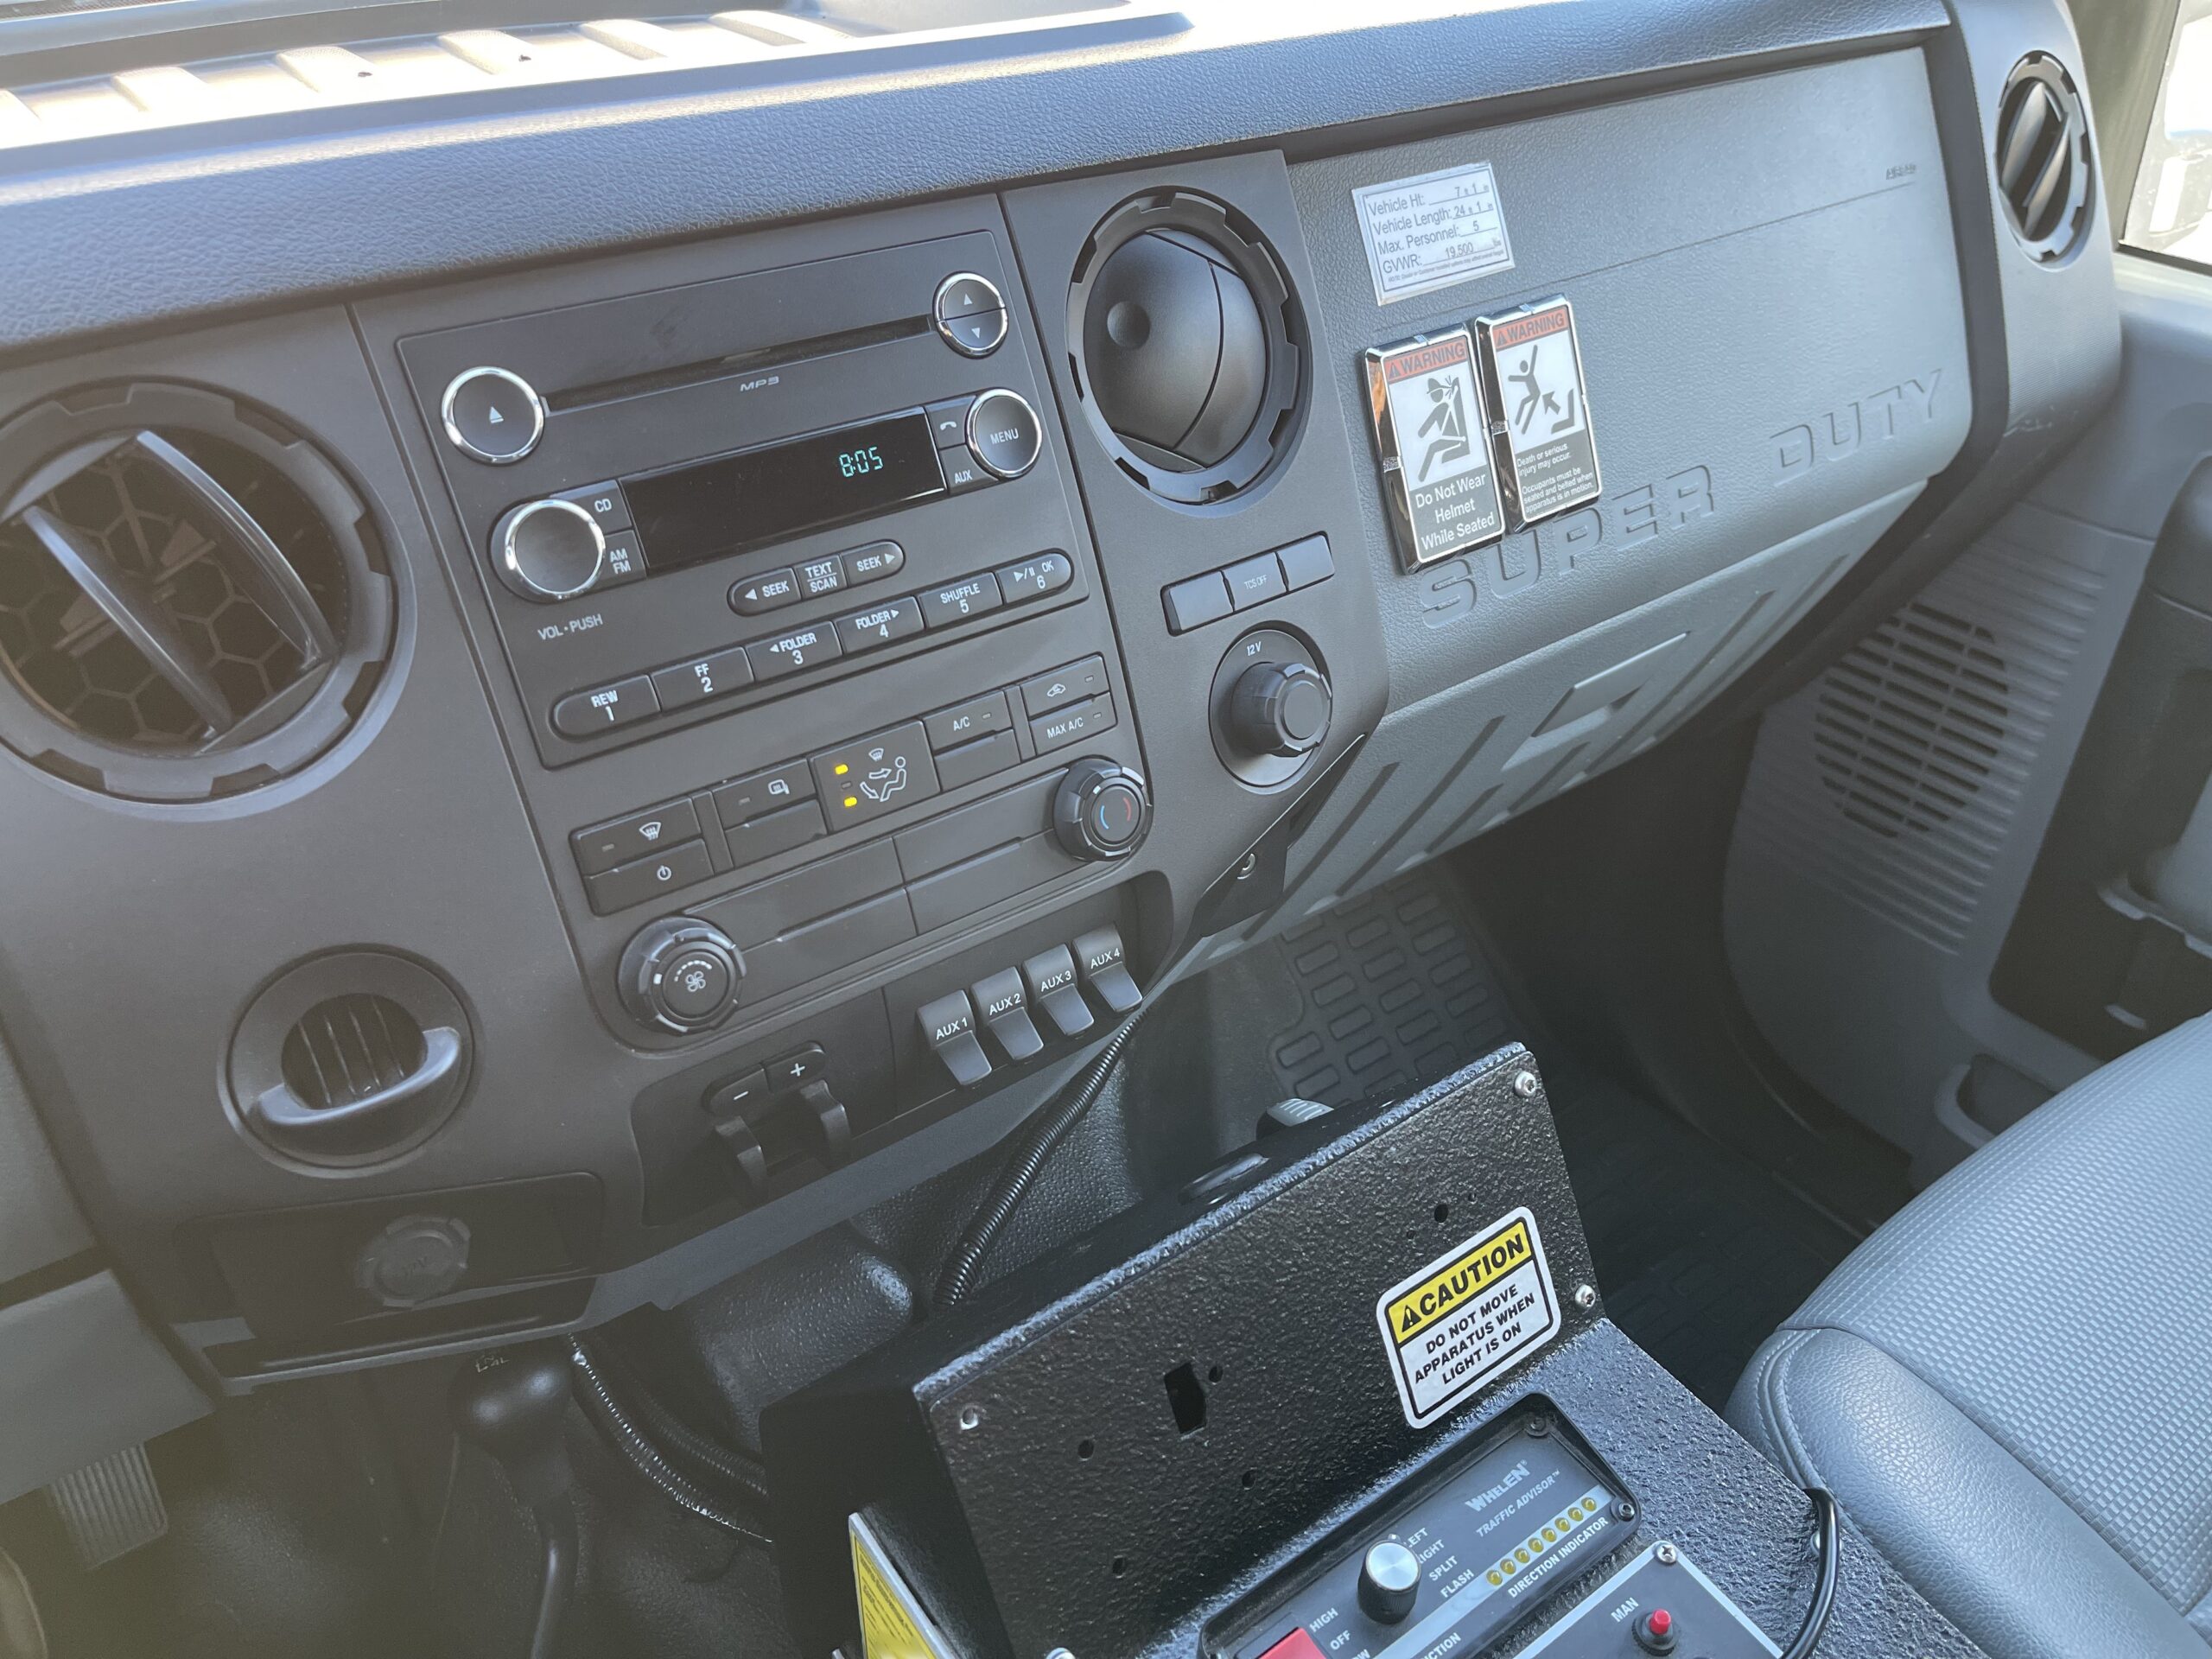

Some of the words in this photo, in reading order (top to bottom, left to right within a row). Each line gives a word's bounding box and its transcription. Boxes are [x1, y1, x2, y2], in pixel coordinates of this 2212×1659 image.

[1369, 198, 1408, 216] Vehicle
[1409, 193, 1425, 207] Ht:
[1454, 187, 1460, 197] 7
[1471, 183, 1478, 194] 1
[1373, 218, 1412, 235] Vehicle
[1414, 209, 1452, 226] Length:
[1454, 205, 1465, 217] 24
[1477, 201, 1482, 212] 1
[1377, 239, 1404, 255] Max.
[1406, 225, 1460, 249] Personnel:
[1472, 220, 1479, 232] 5
[1382, 253, 1422, 274] GVWR:
[1507, 313, 1566, 339] WARNING
[1402, 341, 1465, 372] WARNING
[741, 376, 779, 391] MP3
[990, 429, 1020, 445] MENU
[839, 446, 883, 477] 8:05
[1516, 454, 1535, 467] Death
[1544, 443, 1568, 457] serious
[954, 469, 973, 484] AUX
[1519, 465, 1537, 477] injury
[1537, 459, 1551, 470] may
[1415, 490, 1433, 509] Do
[1434, 482, 1456, 504] Not
[1459, 474, 1486, 498] Wear
[1522, 476, 1556, 495] Occupants
[1556, 469, 1573, 481] must
[1572, 467, 1581, 476] be
[1523, 490, 1544, 505] seated
[1545, 486, 1557, 495] and
[1576, 472, 1593, 484] when
[594, 499, 613, 512] CD
[1421, 464, 1717, 629] SUPER
[1769, 368, 1945, 490] DUTY
[1525, 497, 1556, 513] apparatus
[1435, 498, 1476, 524] Helmet
[1421, 527, 1455, 550] While
[1456, 512, 1495, 539] Seated
[609, 548, 628, 563] AM
[856, 556, 882, 572] SEEK
[1041, 560, 1055, 573] OK
[613, 560, 632, 575] FM
[804, 562, 832, 579] TEXT
[762, 581, 790, 598] SEEK
[810, 576, 838, 593] SCAN
[1036, 575, 1046, 589] 6
[940, 583, 981, 604] SHUFFLE
[959, 599, 969, 613] 5
[855, 610, 891, 629] FOLDER
[779, 632, 817, 652] FOLDER
[879, 624, 889, 638] 4
[792, 650, 804, 664] 3
[1246, 640, 1262, 657] 12V
[694, 663, 709, 677] FF
[701, 677, 714, 693] 2
[590, 690, 619, 708] REW
[606, 706, 615, 721] 1
[953, 715, 970, 731] A/C
[1046, 722, 1066, 740] MAX
[1068, 716, 1084, 732] A/C
[1090, 950, 1113, 969] AUX
[1112, 947, 1122, 959] 4
[1039, 974, 1064, 993] AUX
[1064, 969, 1072, 982] 3
[988, 996, 1012, 1016] AUX
[1013, 993, 1021, 1006] 2
[936, 1020, 960, 1040] AUX
[963, 1016, 969, 1028] 1
[1419, 1233, 1525, 1315] CAUTION
[1426, 1336, 1446, 1355] DO
[1448, 1311, 1478, 1338] NOT
[1479, 1284, 1519, 1319] MOVE
[1414, 1321, 1495, 1384] APPARATUS
[1496, 1292, 1535, 1326] WHEN
[1441, 1351, 1483, 1385] LIGHT
[1486, 1338, 1500, 1355] IS
[1503, 1322, 1522, 1343] ON
[1476, 1506, 1516, 1538] TRAFFIC
[1419, 1539, 1445, 1564] IGHT
[1508, 1549, 1561, 1599] DIRECTION
[1557, 1516, 1609, 1559] INDICATOR
[1428, 1555, 1459, 1582] SPLIT
[1440, 1568, 1475, 1599] FLASH
[1309, 1607, 1339, 1633] HIGH
[1610, 1596, 1640, 1624] MAN
[1330, 1630, 1352, 1651] OFF
